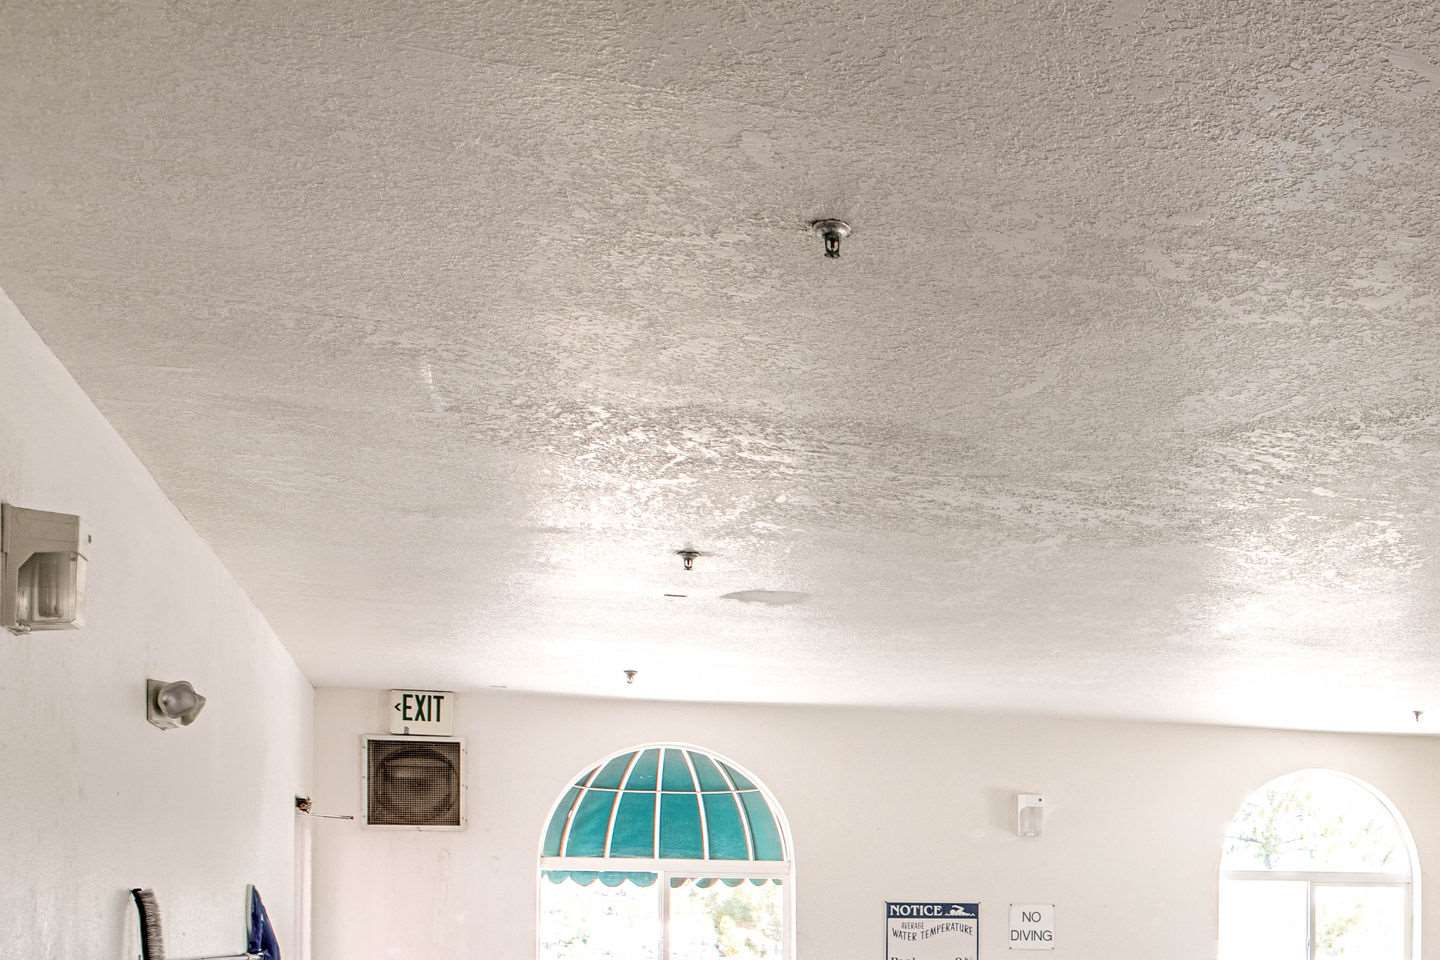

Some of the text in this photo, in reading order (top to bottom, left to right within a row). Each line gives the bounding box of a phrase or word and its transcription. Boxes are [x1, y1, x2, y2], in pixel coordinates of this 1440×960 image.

[402, 694, 444, 722] EXIT
[890, 905, 942, 916] NOTICE
[1022, 912, 1041, 923] NO
[892, 923, 973, 942] WATER TEMPERATURE
[1010, 930, 1052, 941] DIVING
